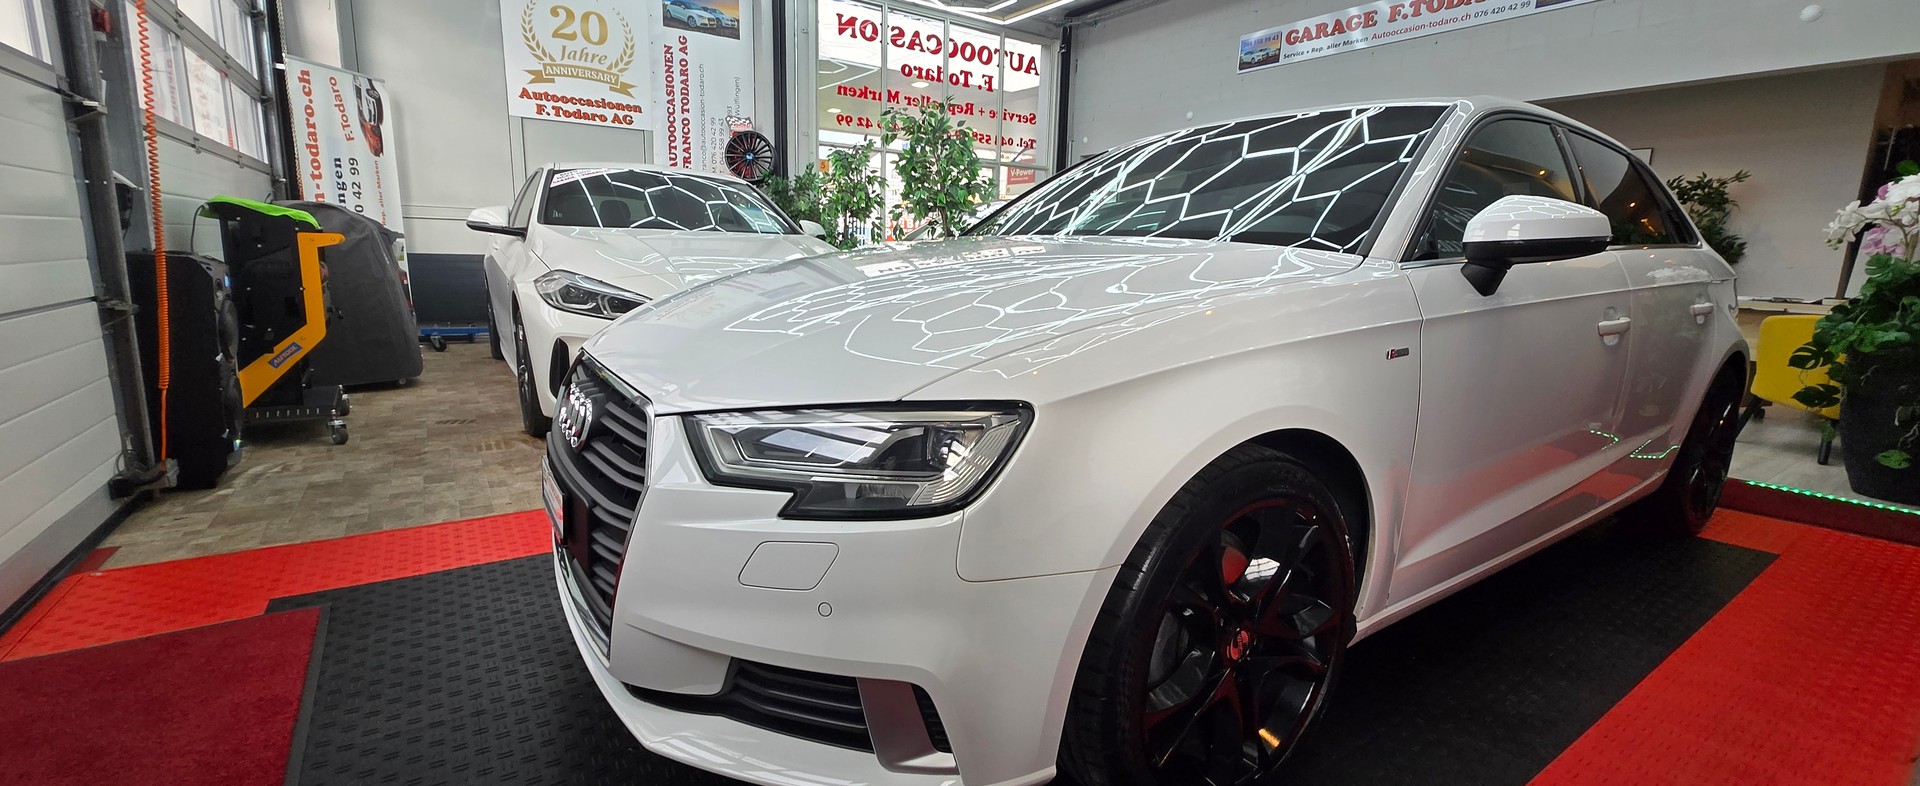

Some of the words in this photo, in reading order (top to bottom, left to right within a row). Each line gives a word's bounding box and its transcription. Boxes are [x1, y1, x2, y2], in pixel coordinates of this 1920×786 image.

[549, 5, 608, 46] 20
[1283, 49, 1305, 59] Service
[1311, 46, 1325, 54] Rep.
[1326, 42, 1341, 50] aller
[1342, 36, 1369, 47] Marken
[1371, 12, 1472, 40] Autooccasion-todaro.ch
[1474, 8, 1489, 18] 076
[1490, 5, 1506, 15] 420
[1507, 3, 1518, 11] 42
[1520, 0, 1531, 9] 99
[1285, 10, 1378, 46] GARAGE
[560, 45, 608, 65] Jahre
[679, 35, 688, 56] AG
[546, 66, 618, 84] ANNIVERSARY
[679, 58, 690, 114] TODARO
[329, 76, 355, 141] F.Todaro
[519, 87, 643, 114] Autooccasionen
[535, 103, 551, 117] F.
[552, 106, 608, 123] Todaro
[611, 114, 635, 126] AG
[711, 117, 716, 126] 99
[711, 127, 716, 136] 42
[349, 157, 360, 176] 99
[374, 160, 382, 189] Marken
[1010, 168, 1034, 177] V-Power
[333, 157, 347, 208] ngen
[352, 181, 362, 200] 42
[377, 190, 385, 208] aller
